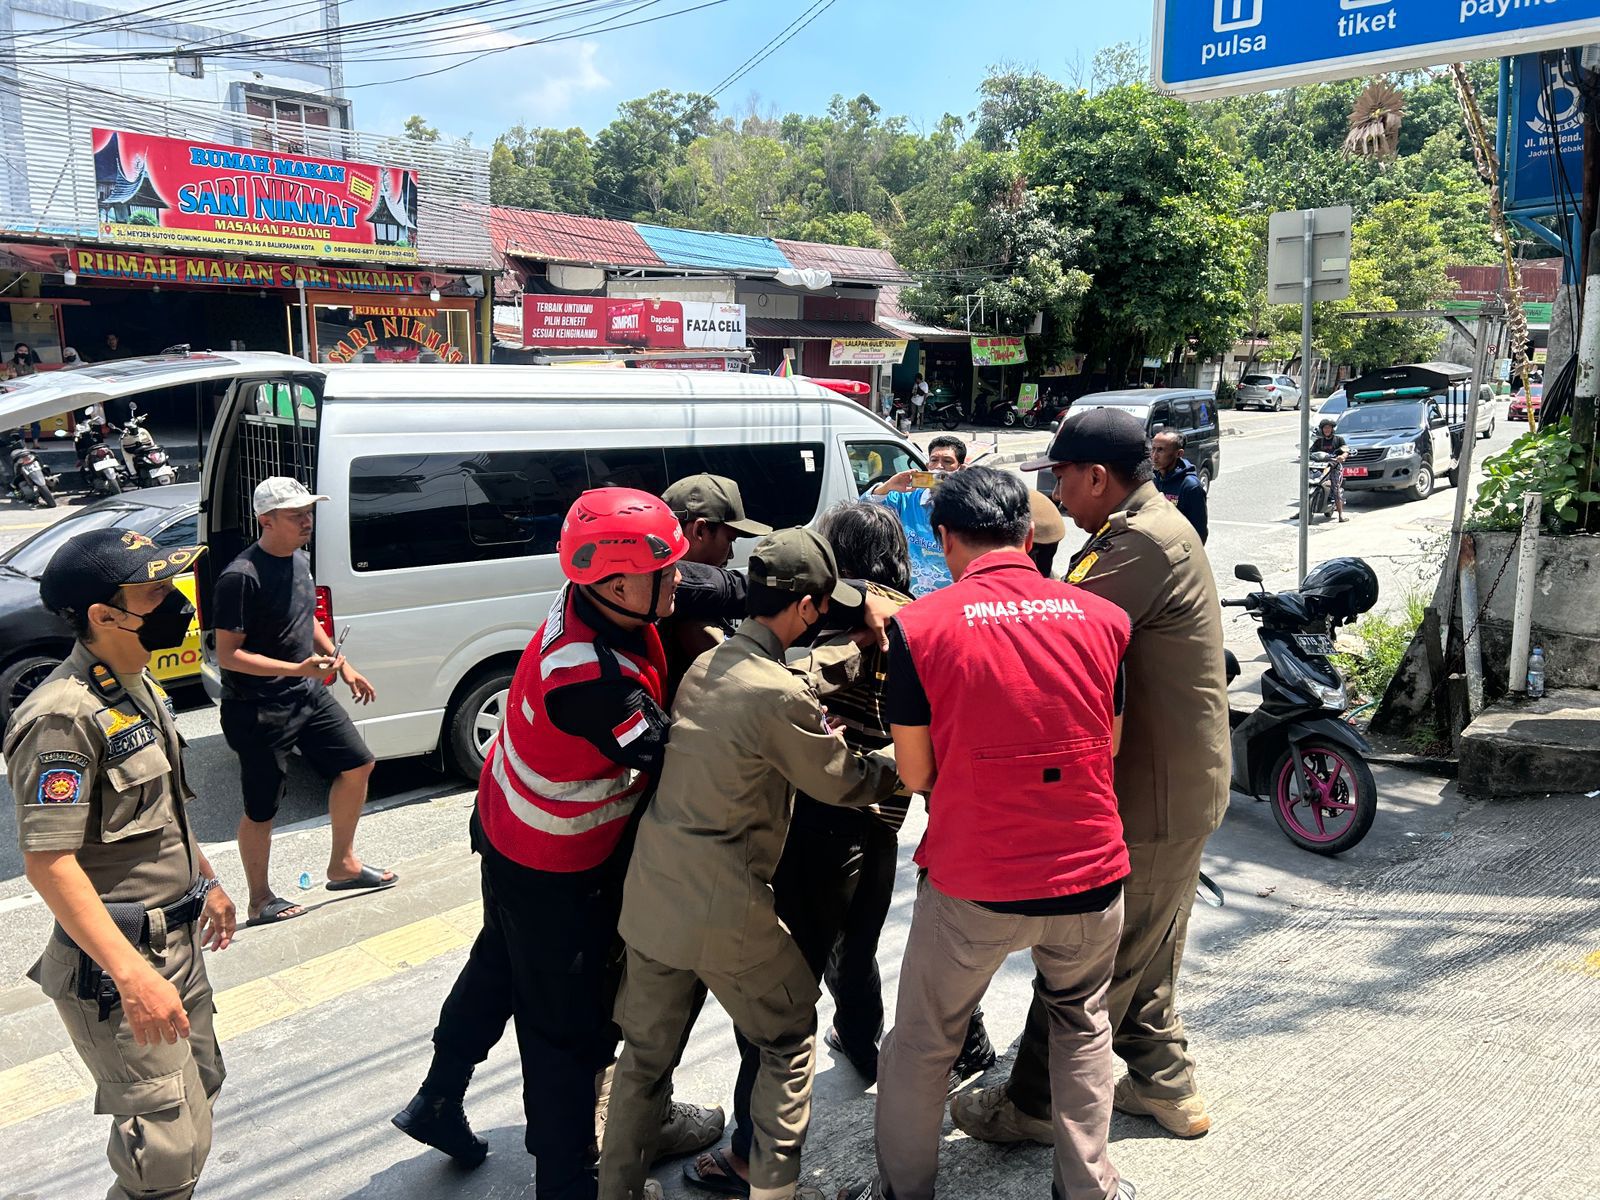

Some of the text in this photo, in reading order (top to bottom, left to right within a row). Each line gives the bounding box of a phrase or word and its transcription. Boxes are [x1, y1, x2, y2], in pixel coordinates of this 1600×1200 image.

[1338, 8, 1397, 37] tiket
[1201, 35, 1267, 65] pulsa
[1524, 139, 1536, 148] Jl.
[190, 148, 345, 182] RUMAH MAKAN
[179, 177, 358, 228] SARI NIKMAT
[215, 220, 331, 239] MASAKAN PADANG
[127, 230, 151, 238] MEYJEN
[152, 232, 176, 240] SUTOYO
[176, 234, 201, 242] GUNUNG
[202, 236, 226, 245] MALANG
[267, 241, 300, 250] BALIKPAPAN
[301, 243, 315, 251] KOTA
[77, 251, 415, 292] RUMAH MAKAN SARI NIKMAT
[355, 306, 436, 317] RUMAH MAKAN
[536, 302, 594, 314] TERBAIK UNTUKMU
[544, 315, 587, 326] PILIH BENEFIT
[612, 314, 638, 329] SIMPATI
[650, 315, 680, 325] Dapatkan
[686, 319, 742, 333] FAZA CELL
[532, 328, 598, 339] SESUAI KEINGINANMU
[655, 324, 675, 333] Di Sini
[328, 316, 464, 364] SARI NIKMAT
[963, 598, 1084, 619] DINAS SOSIAL
[967, 613, 1086, 627] BALIKPAPAN
